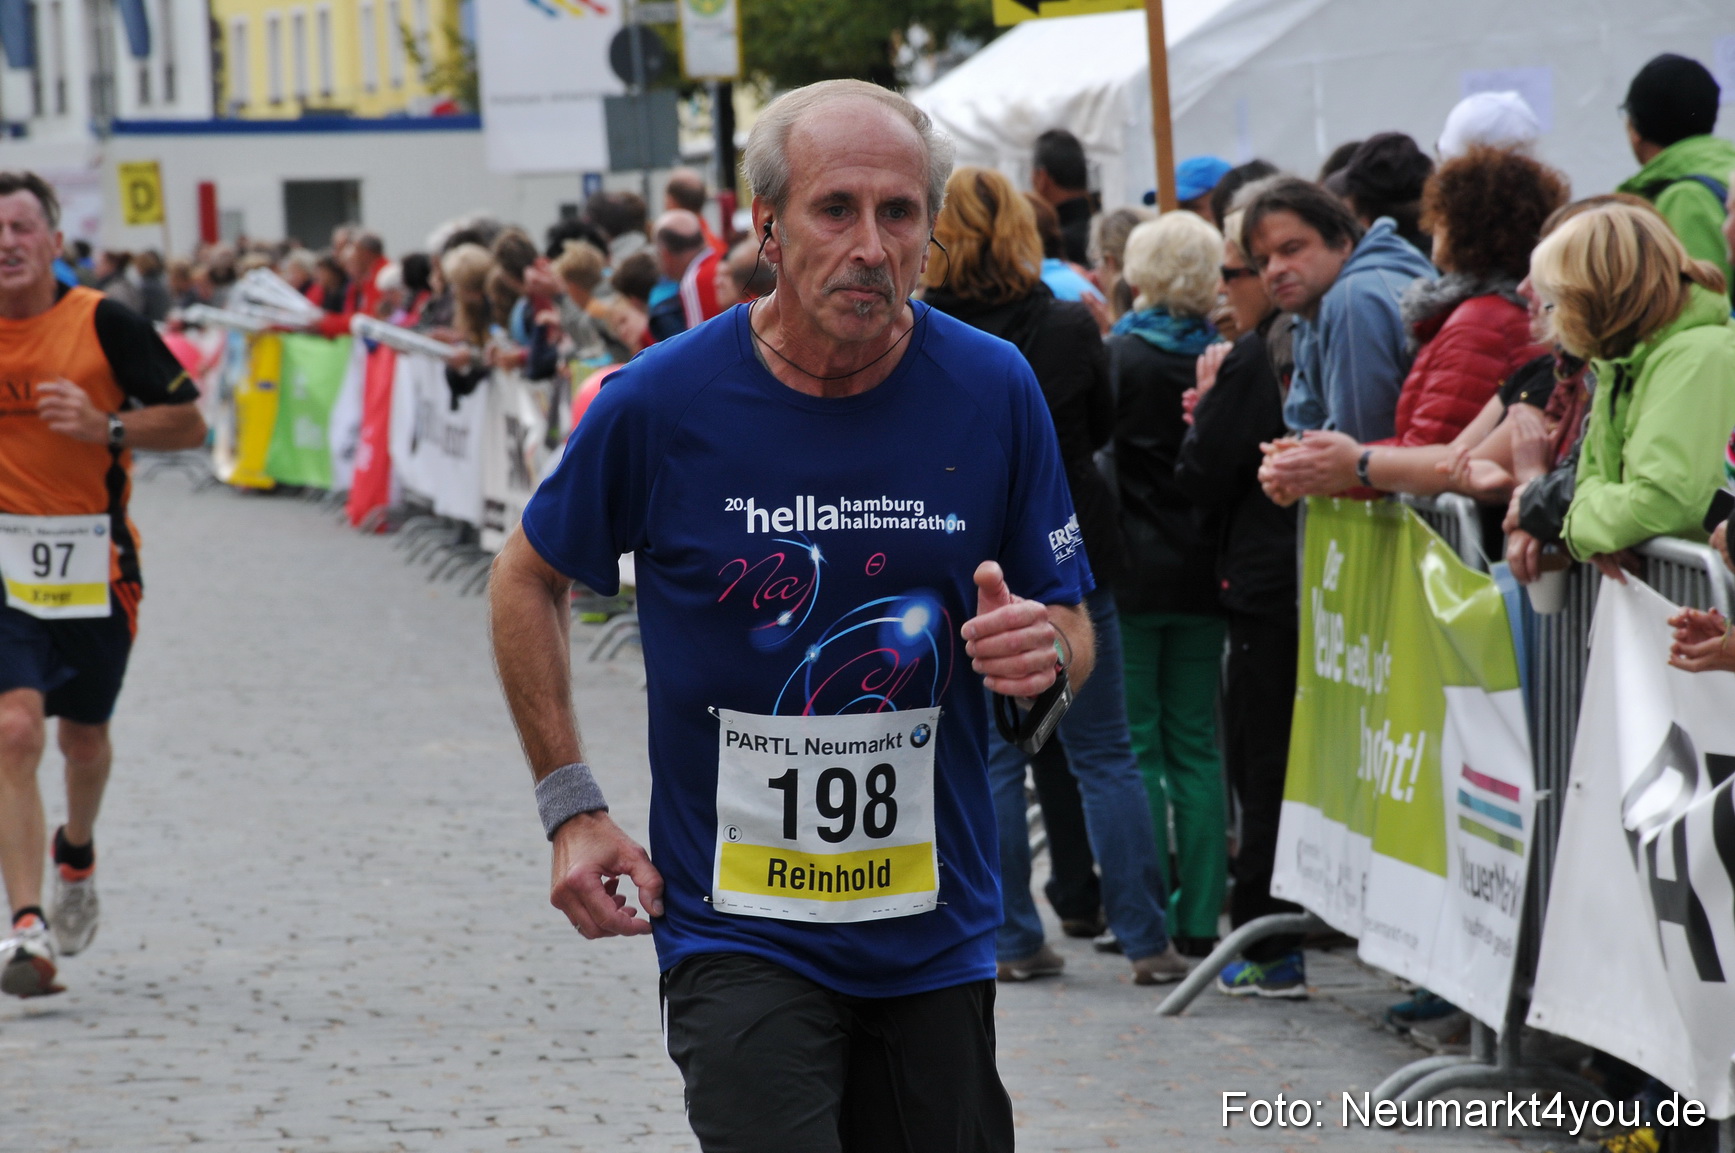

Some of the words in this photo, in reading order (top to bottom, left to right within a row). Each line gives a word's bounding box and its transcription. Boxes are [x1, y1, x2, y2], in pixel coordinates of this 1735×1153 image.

[130, 181, 155, 212] D
[724, 498, 748, 511] 20.
[747, 495, 839, 533] hella
[840, 496, 925, 516] hamburg
[840, 514, 966, 531] halbmarathon
[32, 543, 75, 577] 97
[726, 730, 798, 756] PARTL
[804, 732, 903, 755] Neumarkt
[768, 763, 898, 843] 198
[767, 858, 891, 893] Reinhold
